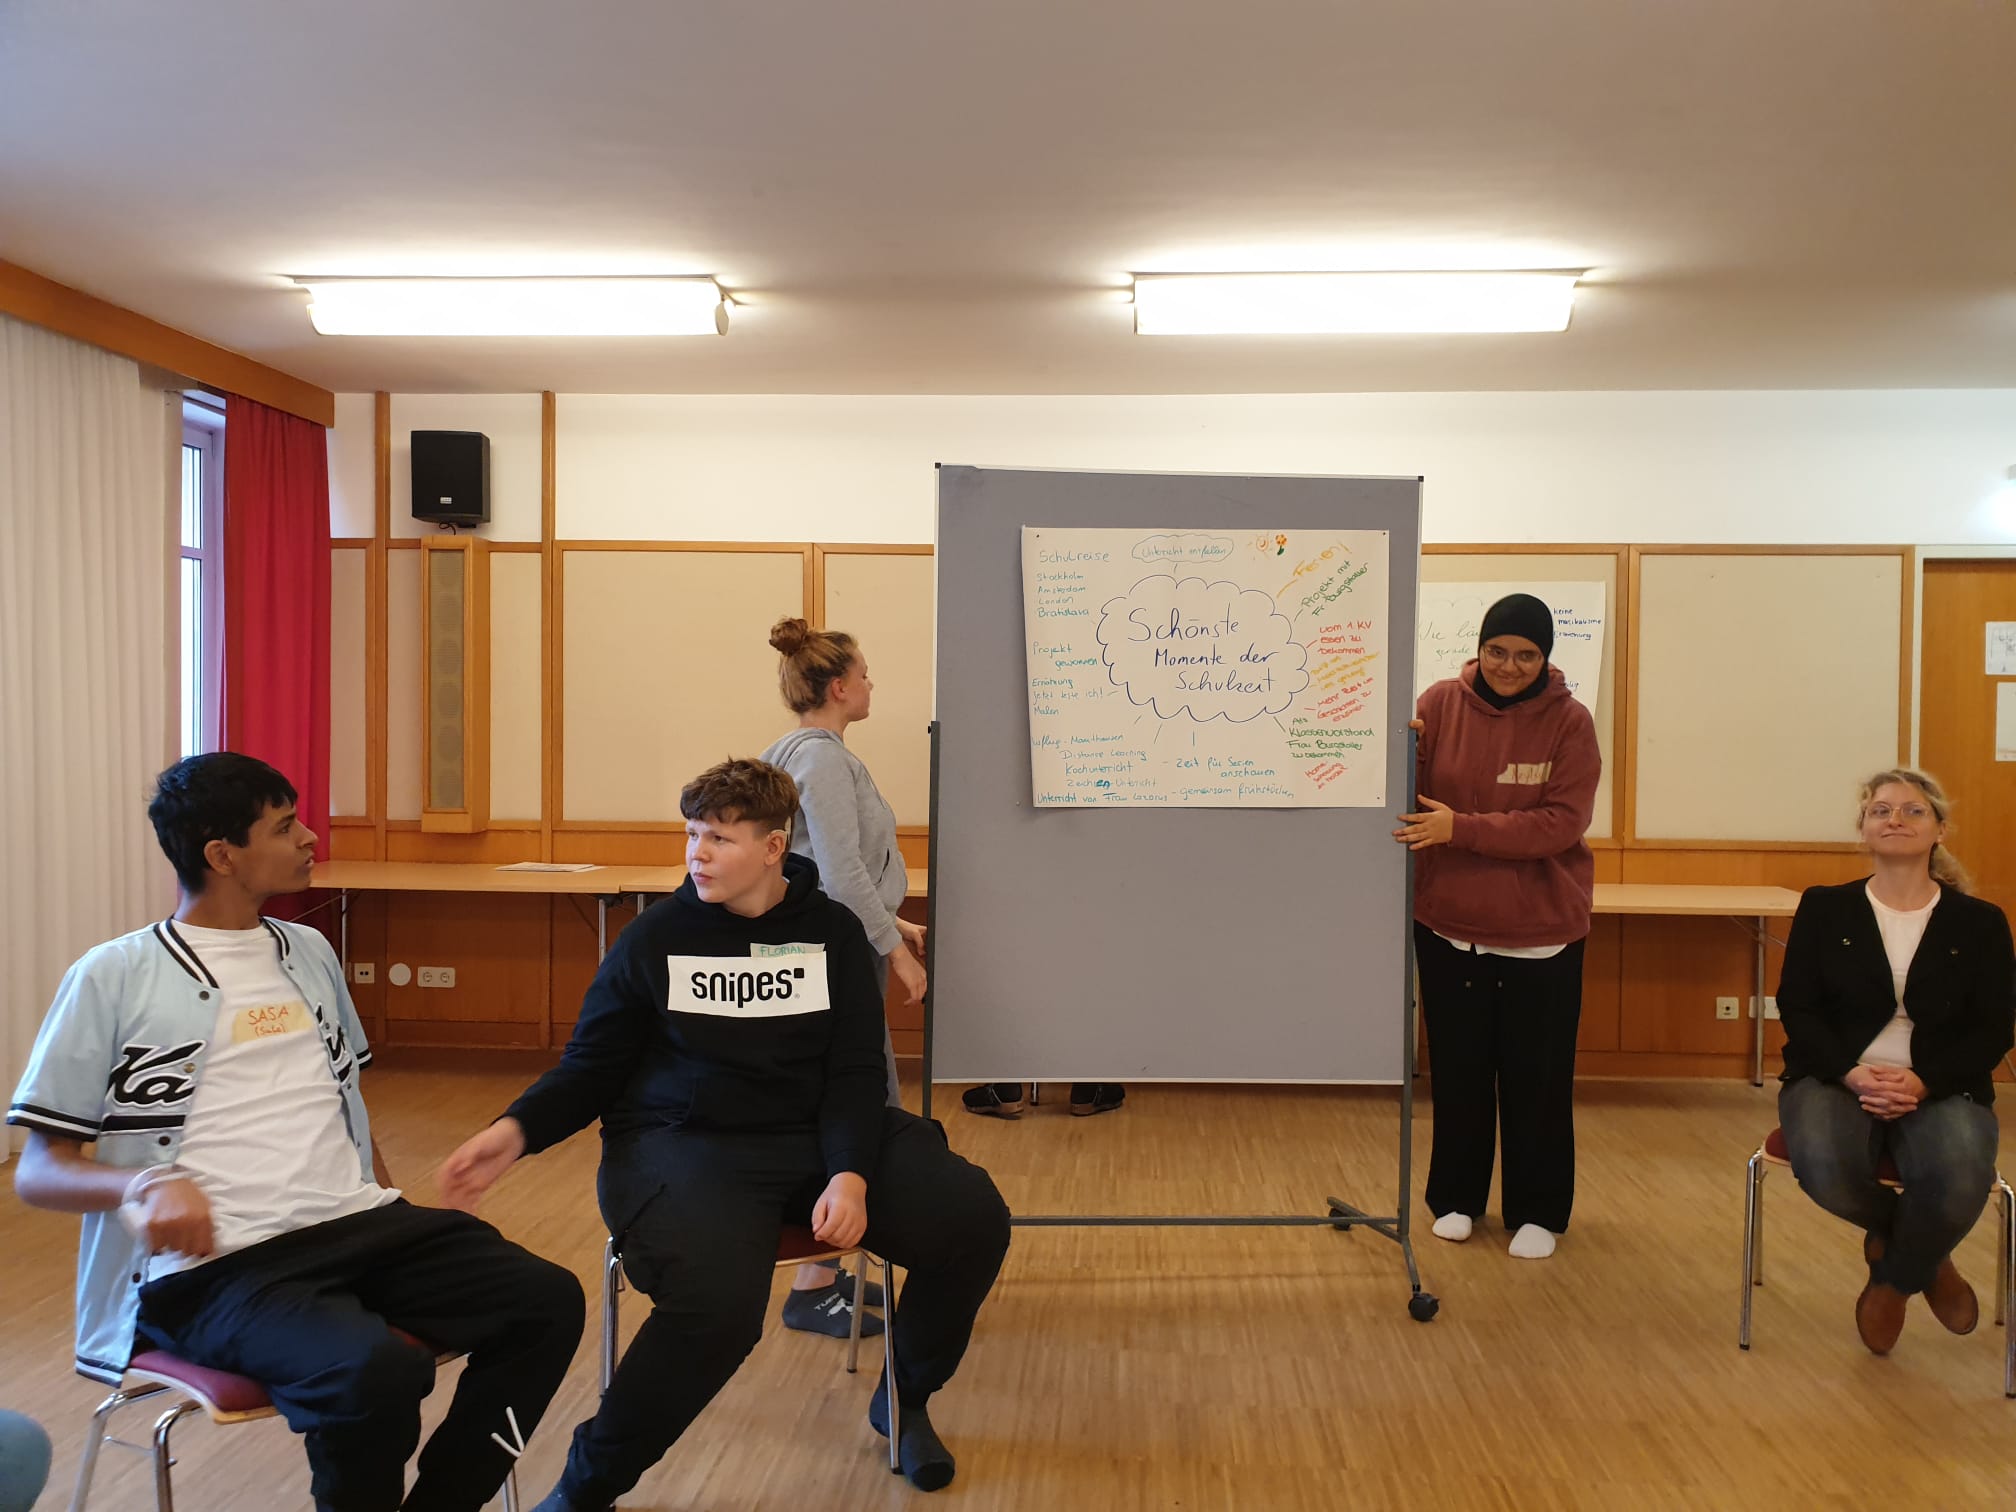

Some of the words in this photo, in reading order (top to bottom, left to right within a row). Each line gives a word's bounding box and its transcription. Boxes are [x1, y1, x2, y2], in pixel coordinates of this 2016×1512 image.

[1154, 643, 1227, 668] Momente
[1239, 642, 1280, 664] der
[760, 945, 806, 958] FLORIAN
